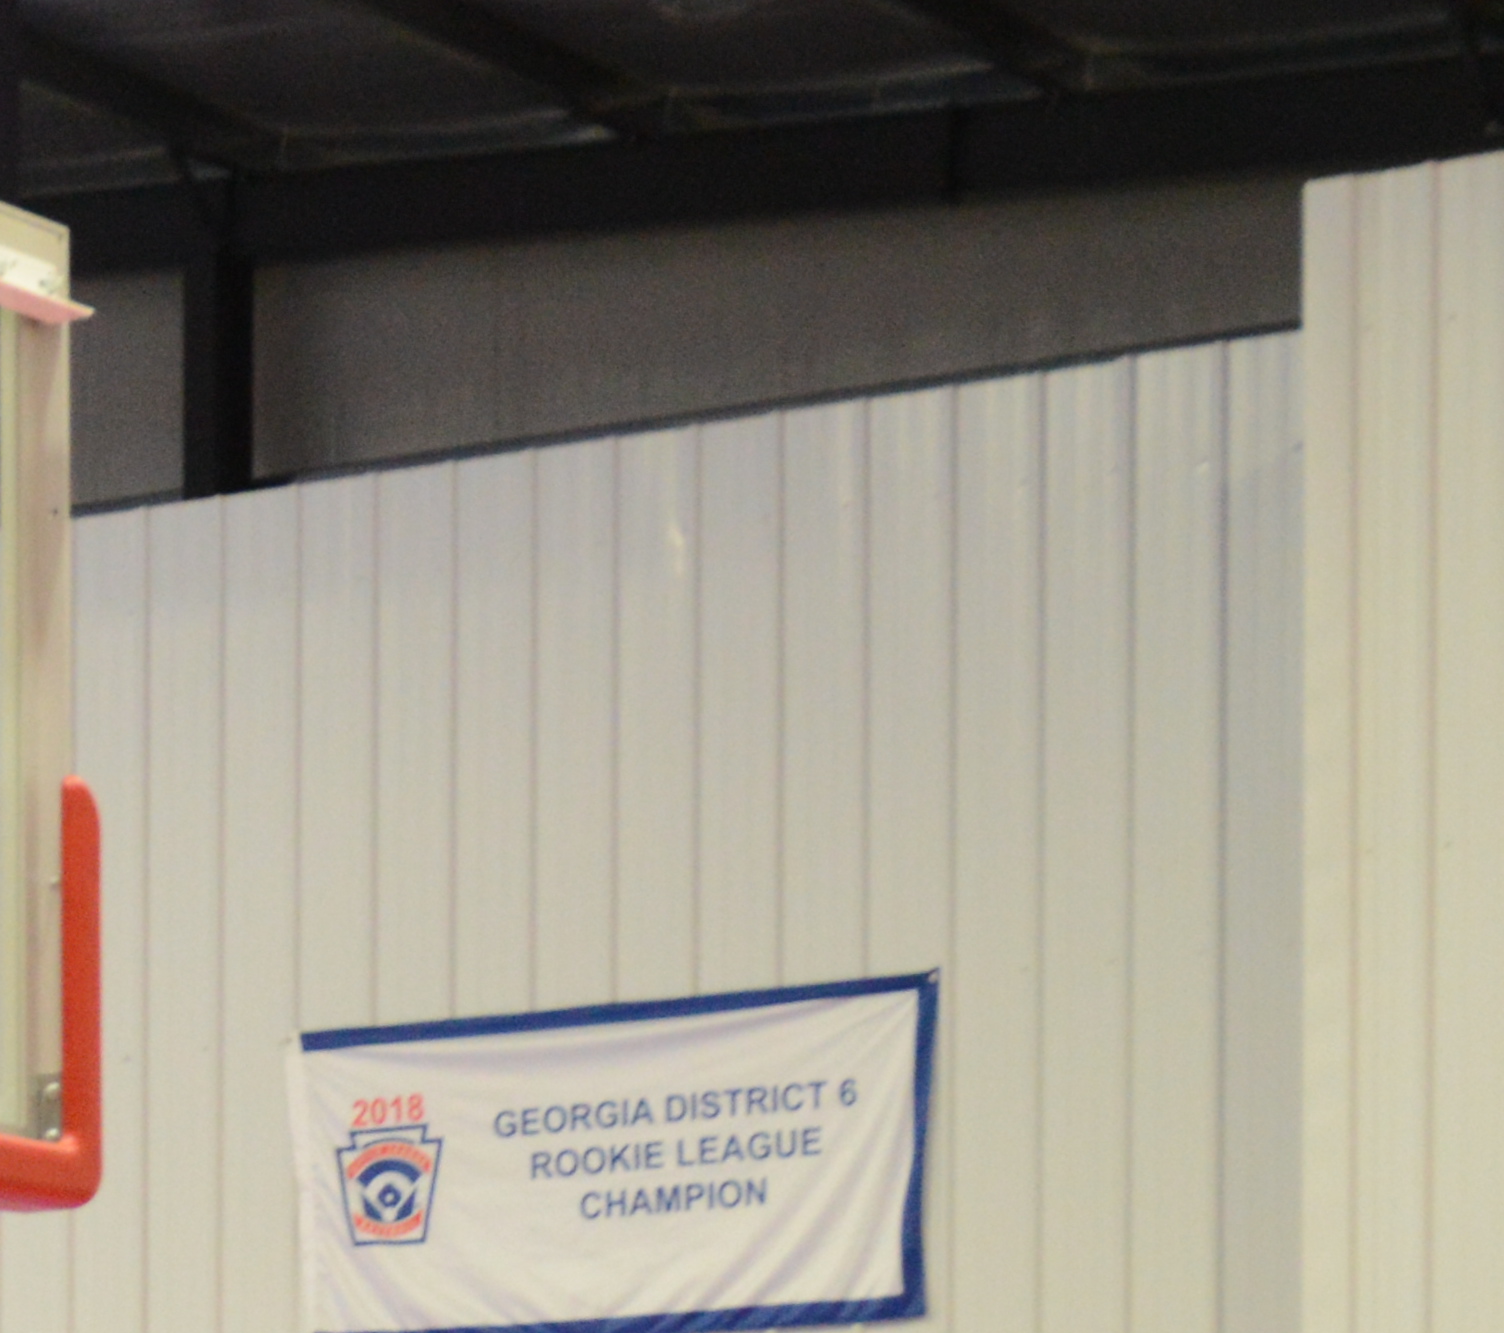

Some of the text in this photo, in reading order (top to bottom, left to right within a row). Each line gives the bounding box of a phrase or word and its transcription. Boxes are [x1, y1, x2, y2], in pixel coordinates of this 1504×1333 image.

[352, 1093, 425, 1127] 2018
[494, 1078, 858, 1139] GEORGIA DISTRICT 6
[530, 1126, 823, 1180] ROOKIE LEAGUE
[580, 1179, 767, 1220] CHAMPION
